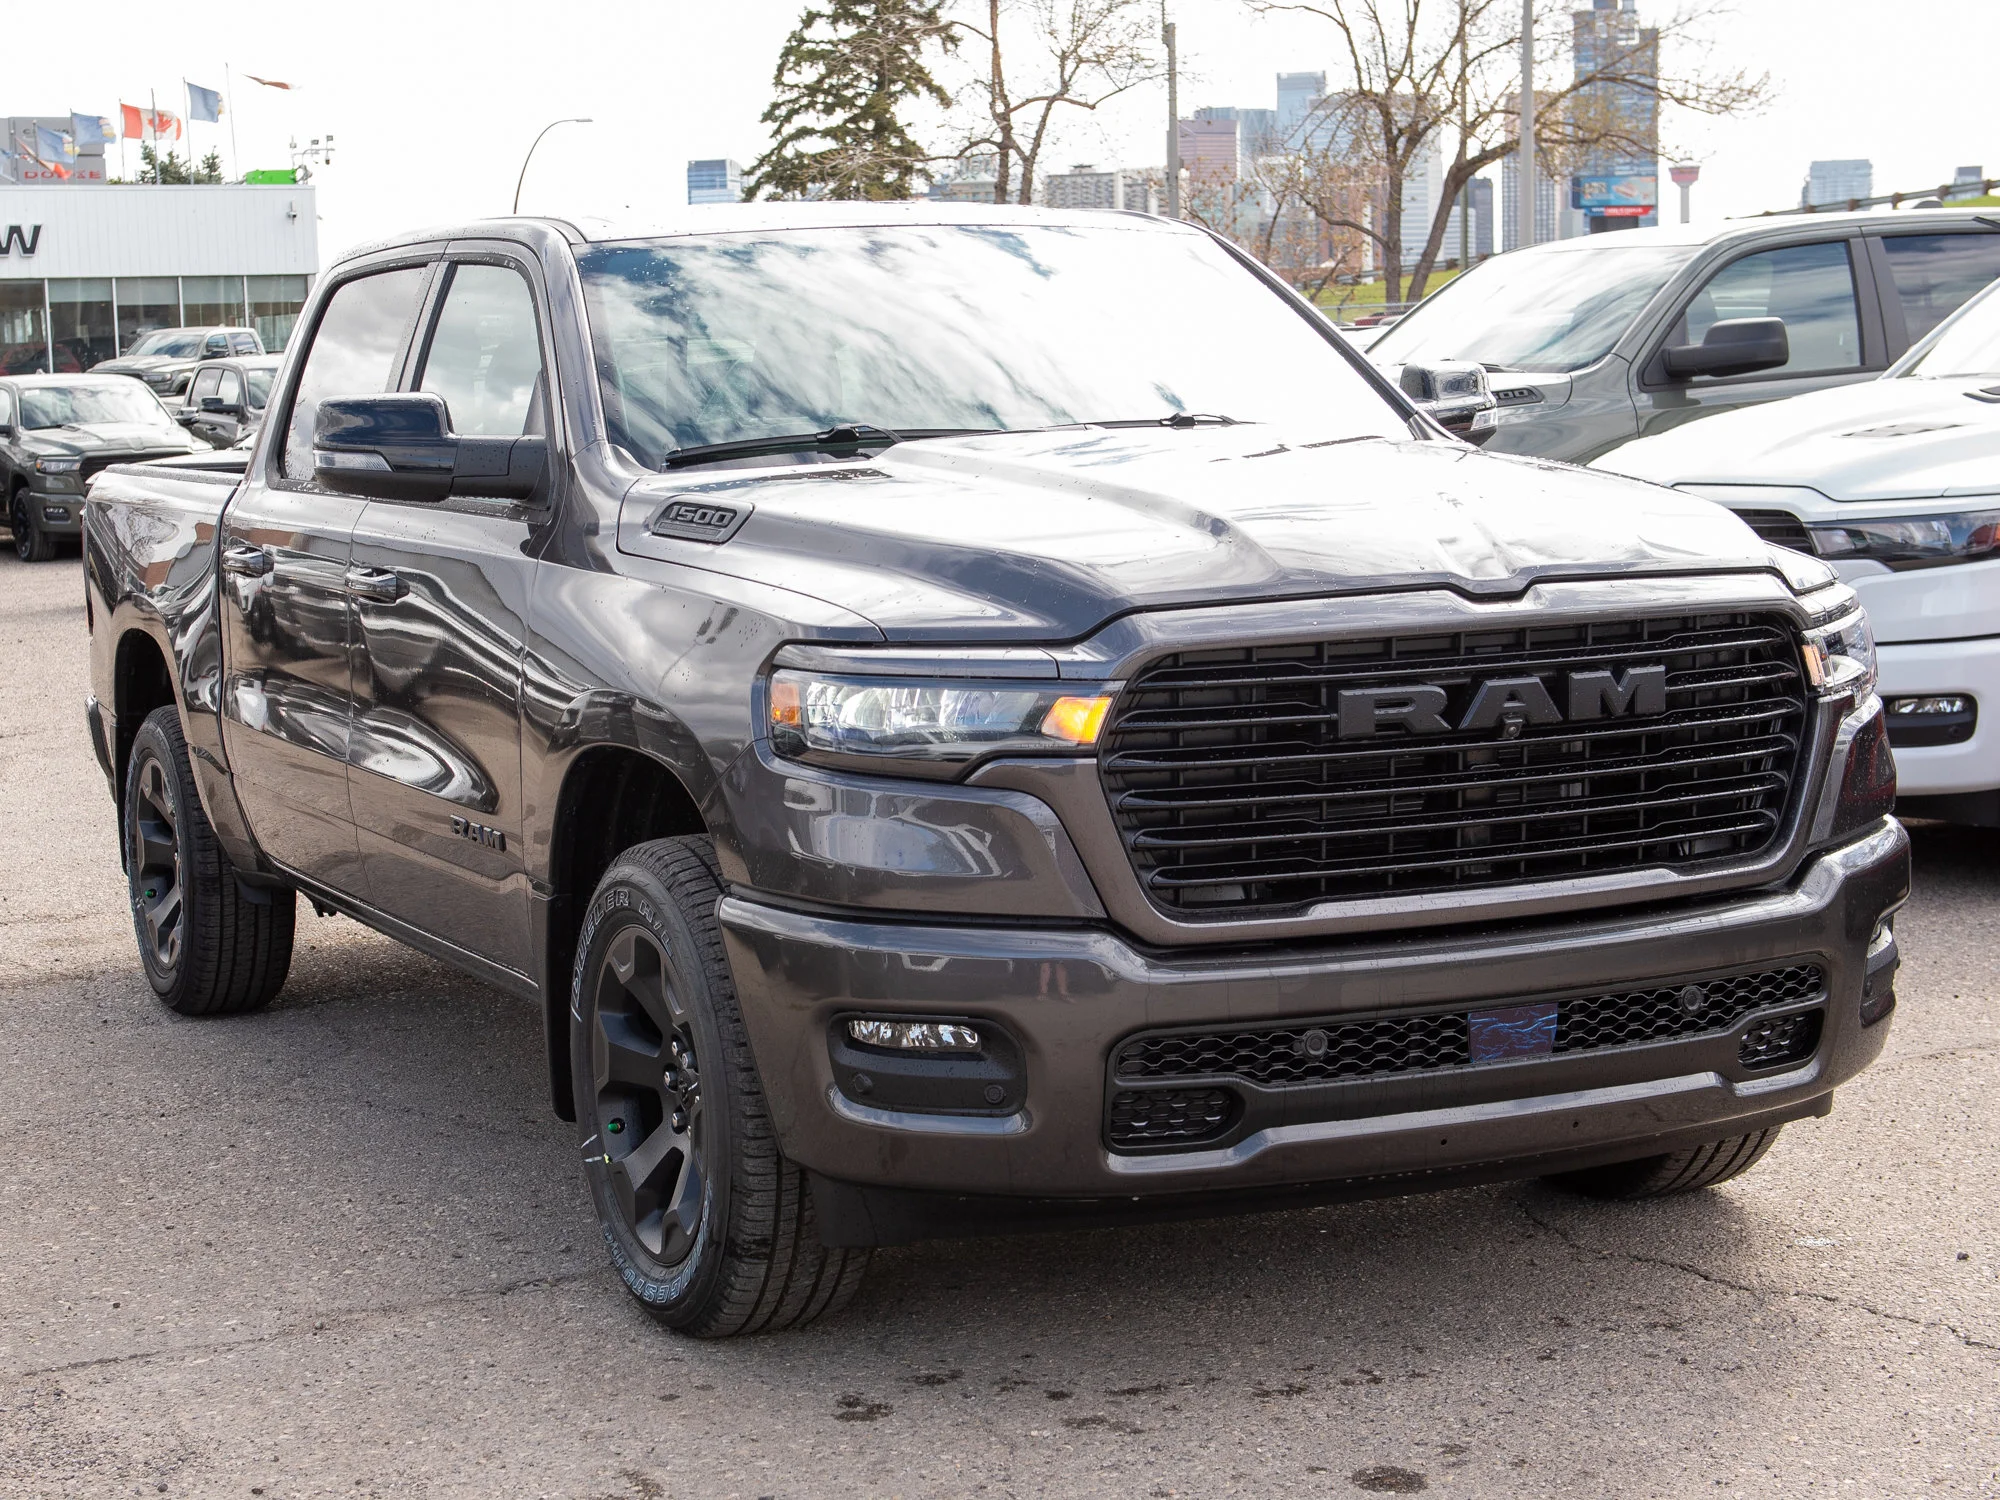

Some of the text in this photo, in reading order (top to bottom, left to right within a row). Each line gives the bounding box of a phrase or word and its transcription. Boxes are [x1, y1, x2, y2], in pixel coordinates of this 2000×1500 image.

[669, 505, 734, 526] 1500
[1338, 664, 1666, 739] RAM
[450, 814, 507, 853] RAM
[572, 888, 630, 1010] DUELER
